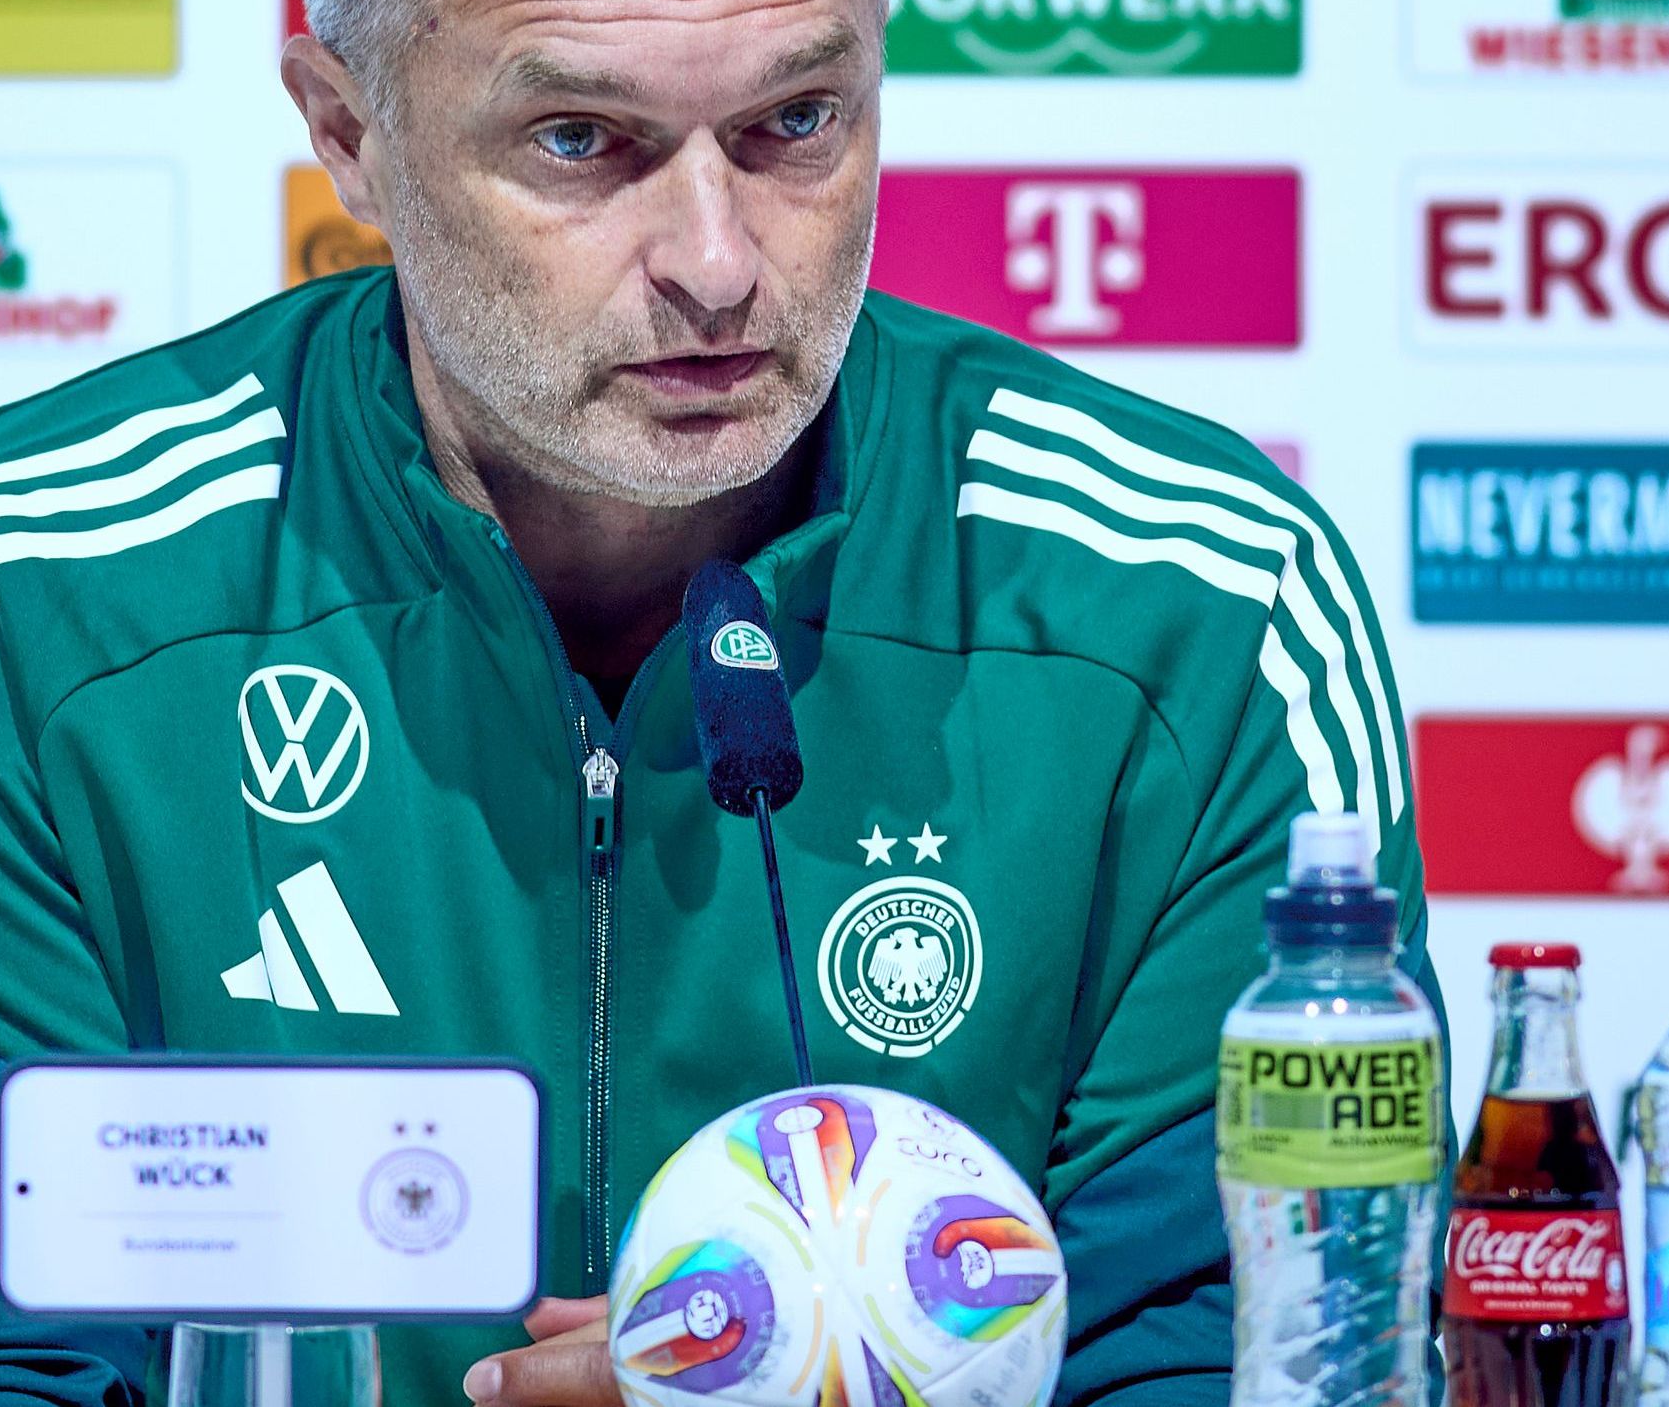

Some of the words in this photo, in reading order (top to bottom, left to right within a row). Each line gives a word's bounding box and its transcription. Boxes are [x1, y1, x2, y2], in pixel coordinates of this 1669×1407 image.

[854, 899, 956, 938] DEUTSCHER
[1249, 1049, 1421, 1088] POWER
[1332, 1092, 1422, 1130] ADE
[98, 1123, 268, 1149] CHRISTIAN
[133, 1155, 232, 1187] WÜCK
[1454, 1216, 1612, 1280] Coca-Cola
